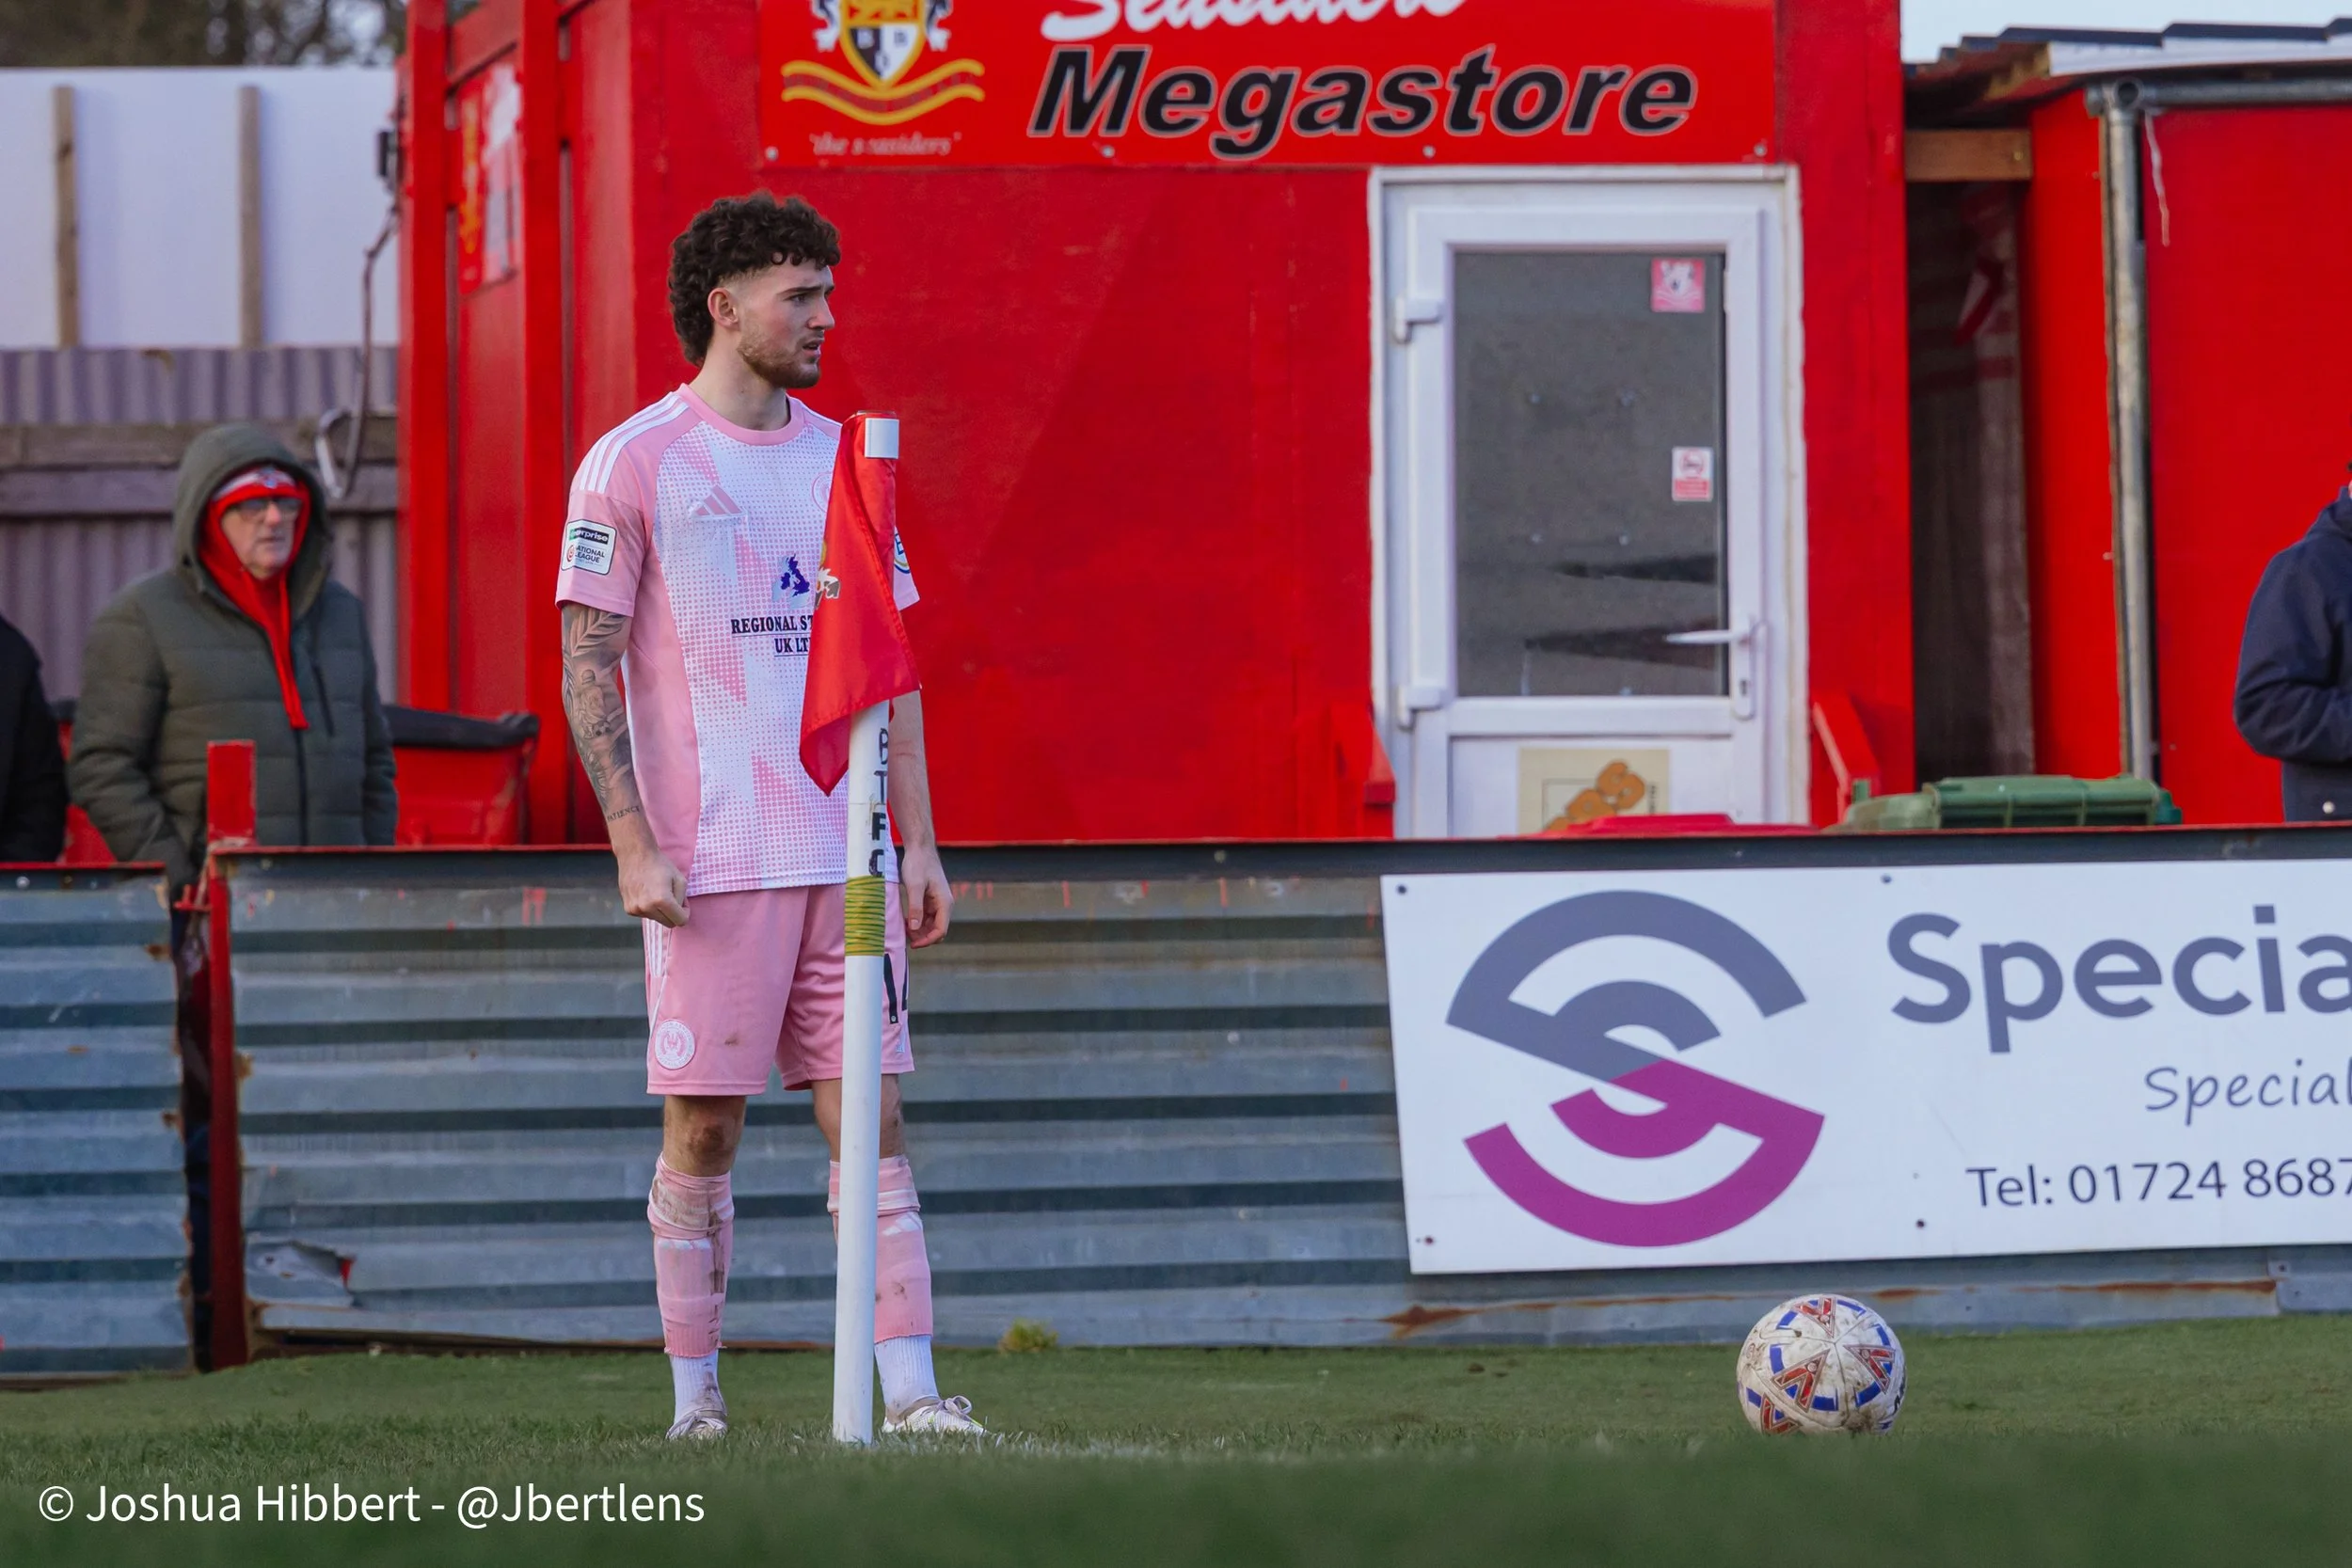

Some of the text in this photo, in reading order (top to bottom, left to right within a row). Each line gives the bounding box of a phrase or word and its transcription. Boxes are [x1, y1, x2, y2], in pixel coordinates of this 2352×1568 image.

[1027, 43, 1699, 161] Megastore
[575, 551, 601, 563] EAGUE
[576, 545, 605, 558] ATIONAL
[731, 615, 798, 634] REGIONAL
[774, 637, 811, 653] UK LT
[1887, 905, 2352, 1053] Specia
[2145, 1056, 2352, 1127] Special
[1965, 1164, 2053, 1208] Tel:
[2069, 1161, 2227, 1205] 01724
